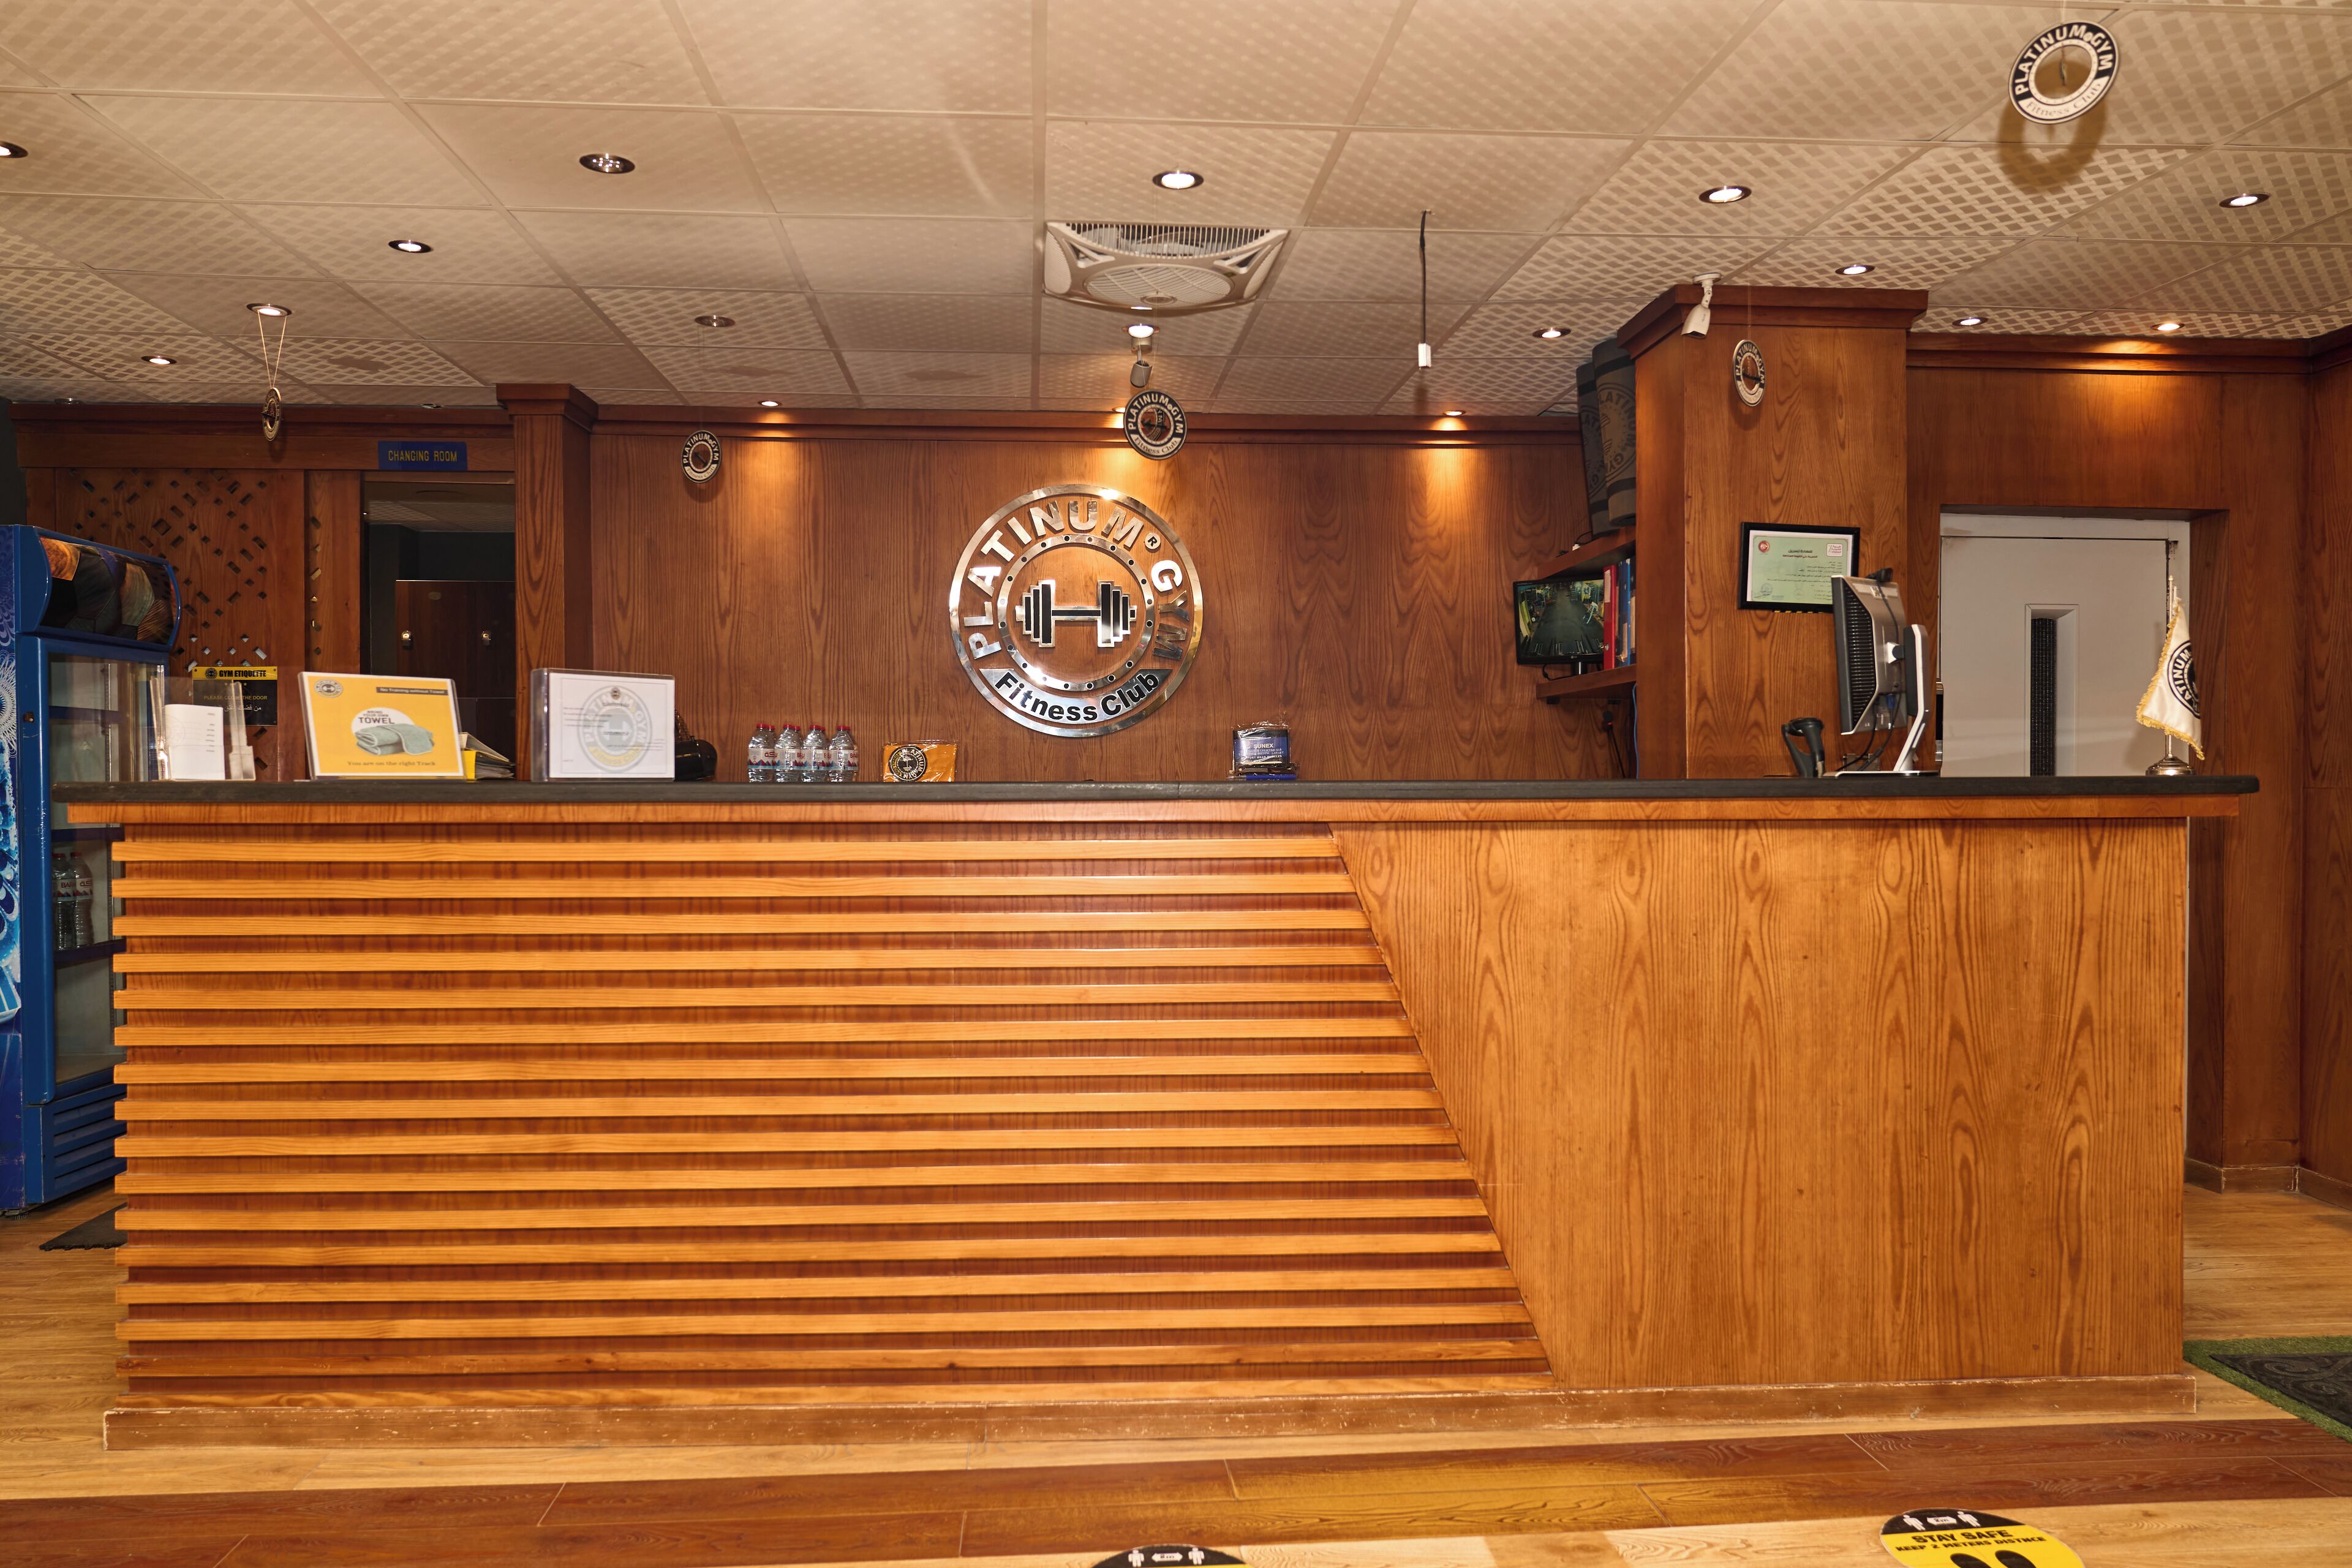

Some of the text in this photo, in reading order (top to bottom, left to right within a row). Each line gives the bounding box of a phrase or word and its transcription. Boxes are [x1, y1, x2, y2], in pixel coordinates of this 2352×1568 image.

[2015, 24, 2113, 96] PLATINUM GYM
[2026, 83, 2101, 116] Fitness Club
[1735, 343, 1758, 376] PLATINUM
[1128, 393, 1183, 434] PLATINUM GYM
[388, 450, 457, 462] CHANGING ROOM
[683, 433, 710, 464] PLATINUM
[1134, 437, 1177, 454] Fitness Club
[1151, 559, 1190, 661] GYM
[994, 671, 1159, 722] Fitness Club
[1911, 1529, 2013, 1544] STAY SAFE
[1943, 1540, 1992, 1548] METERS
